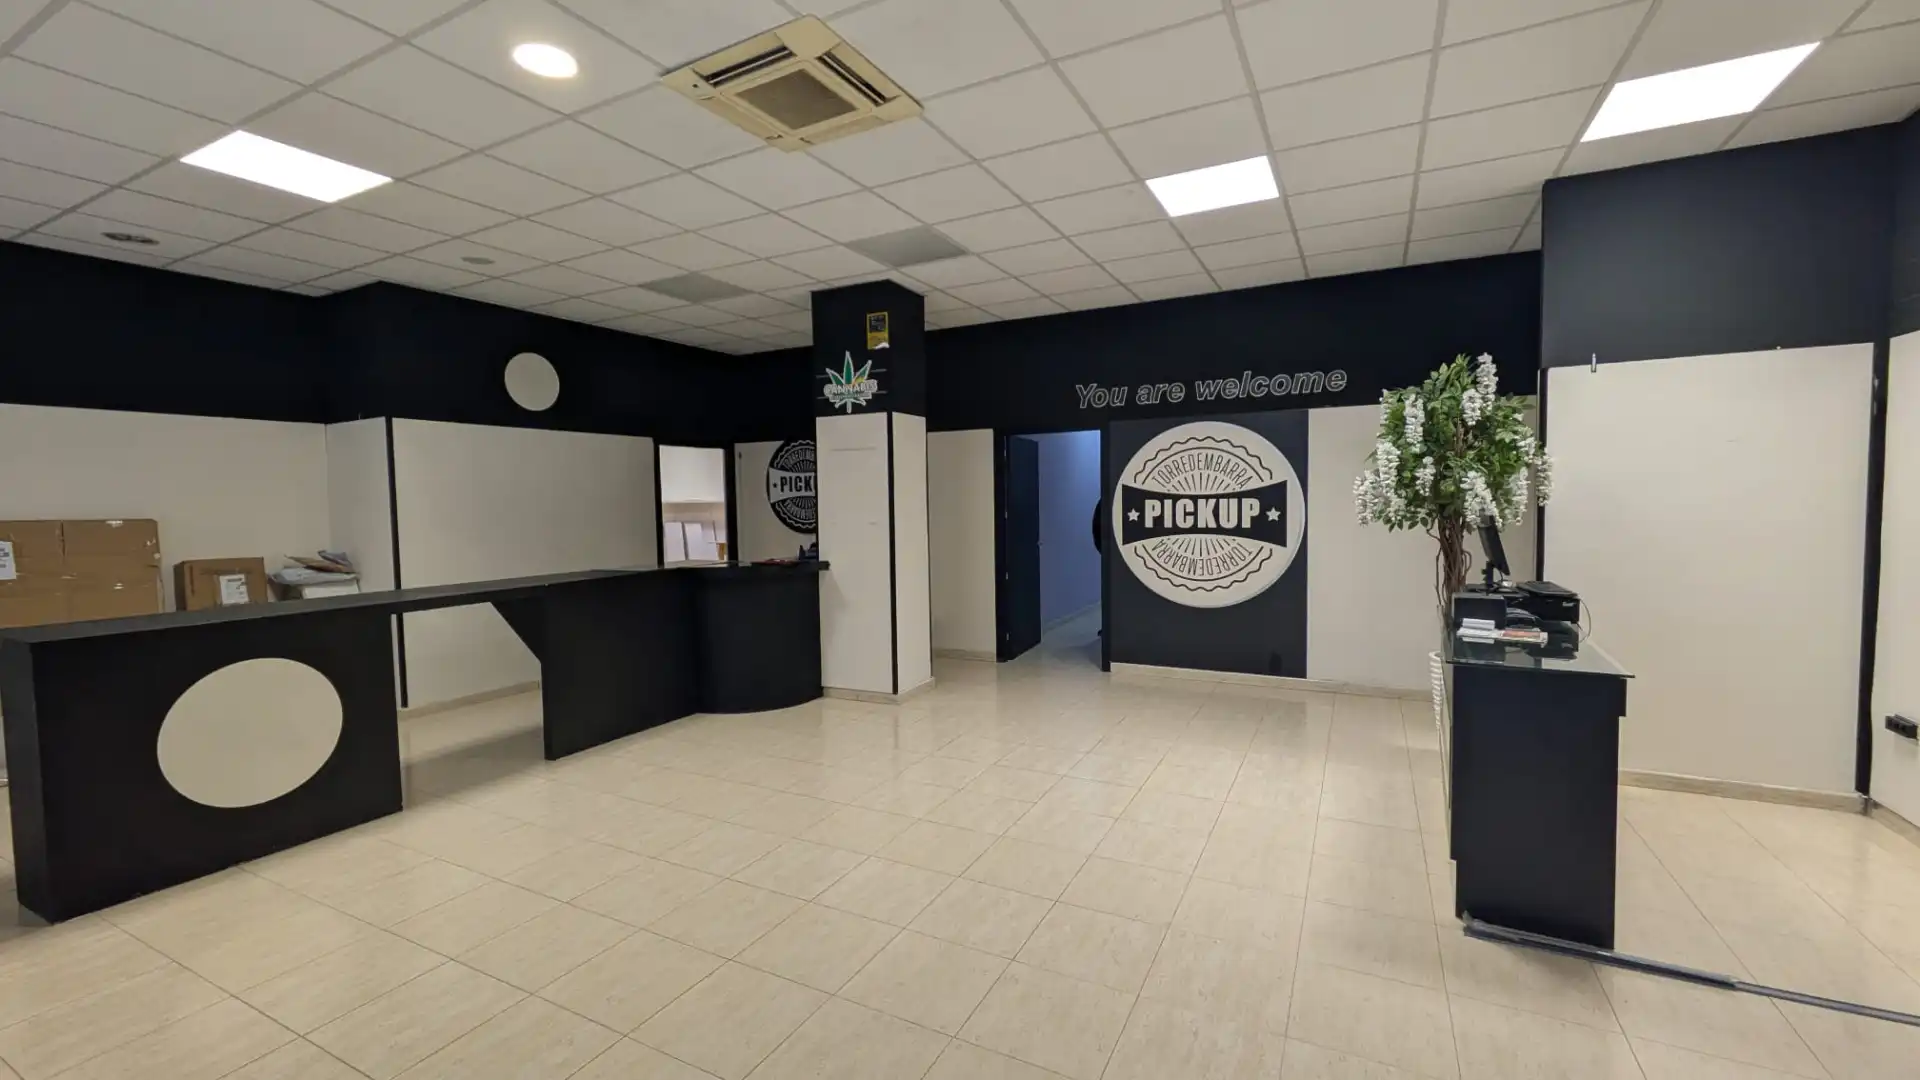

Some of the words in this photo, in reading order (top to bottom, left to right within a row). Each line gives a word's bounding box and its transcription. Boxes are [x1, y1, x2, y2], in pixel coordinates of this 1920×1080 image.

[1075, 383, 1128, 408] You
[1136, 382, 1186, 405] are
[1194, 370, 1348, 400] welcome
[780, 475, 816, 493] PICK
[1152, 452, 1253, 489] TORREDEMBARRA
[1144, 498, 1260, 529] PICKUP
[1152, 539, 1253, 576] TORREDEMBARRA
